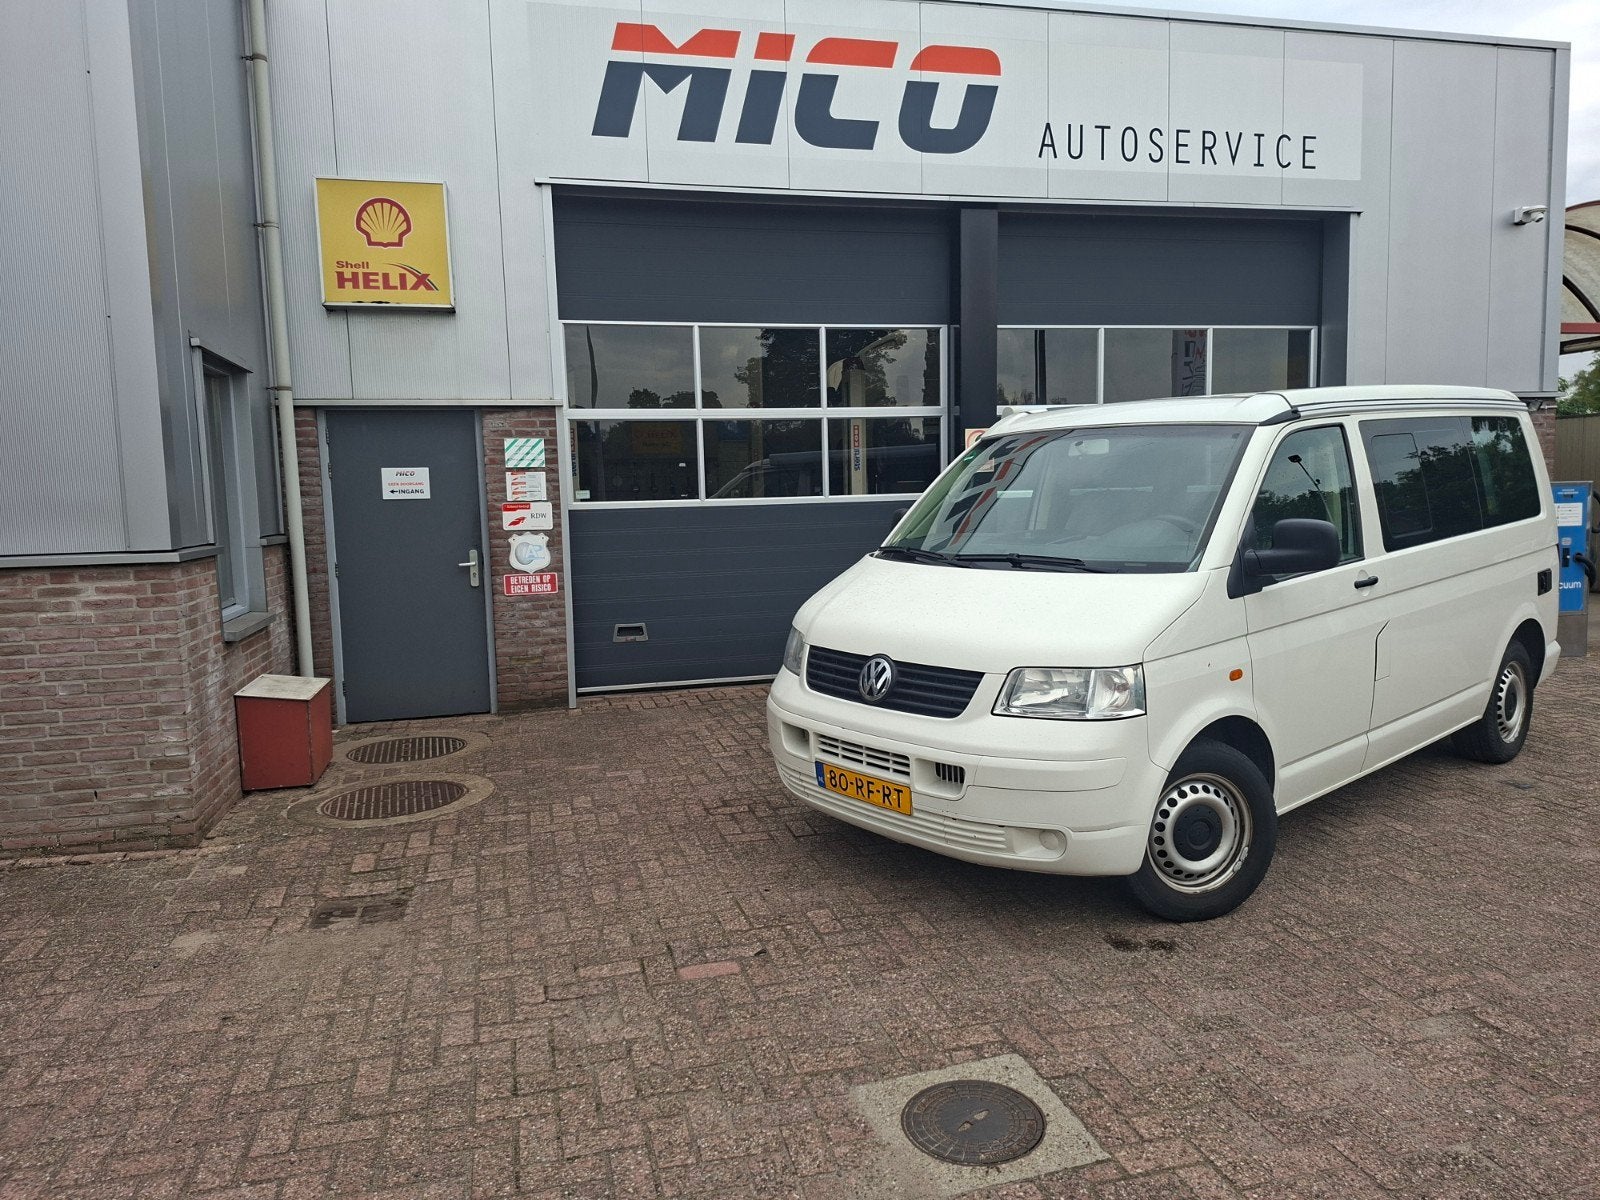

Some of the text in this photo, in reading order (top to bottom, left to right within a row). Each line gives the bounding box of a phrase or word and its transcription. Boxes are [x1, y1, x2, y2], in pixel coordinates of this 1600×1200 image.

[591, 22, 1317, 169] MICO AUTOSERVICE
[336, 261, 369, 269] Shell
[335, 265, 438, 291] HELIX
[510, 574, 551, 585] BETREDEN OP
[510, 583, 552, 593] EIGEN RISICO
[829, 769, 903, 808] 80-RF-RT
